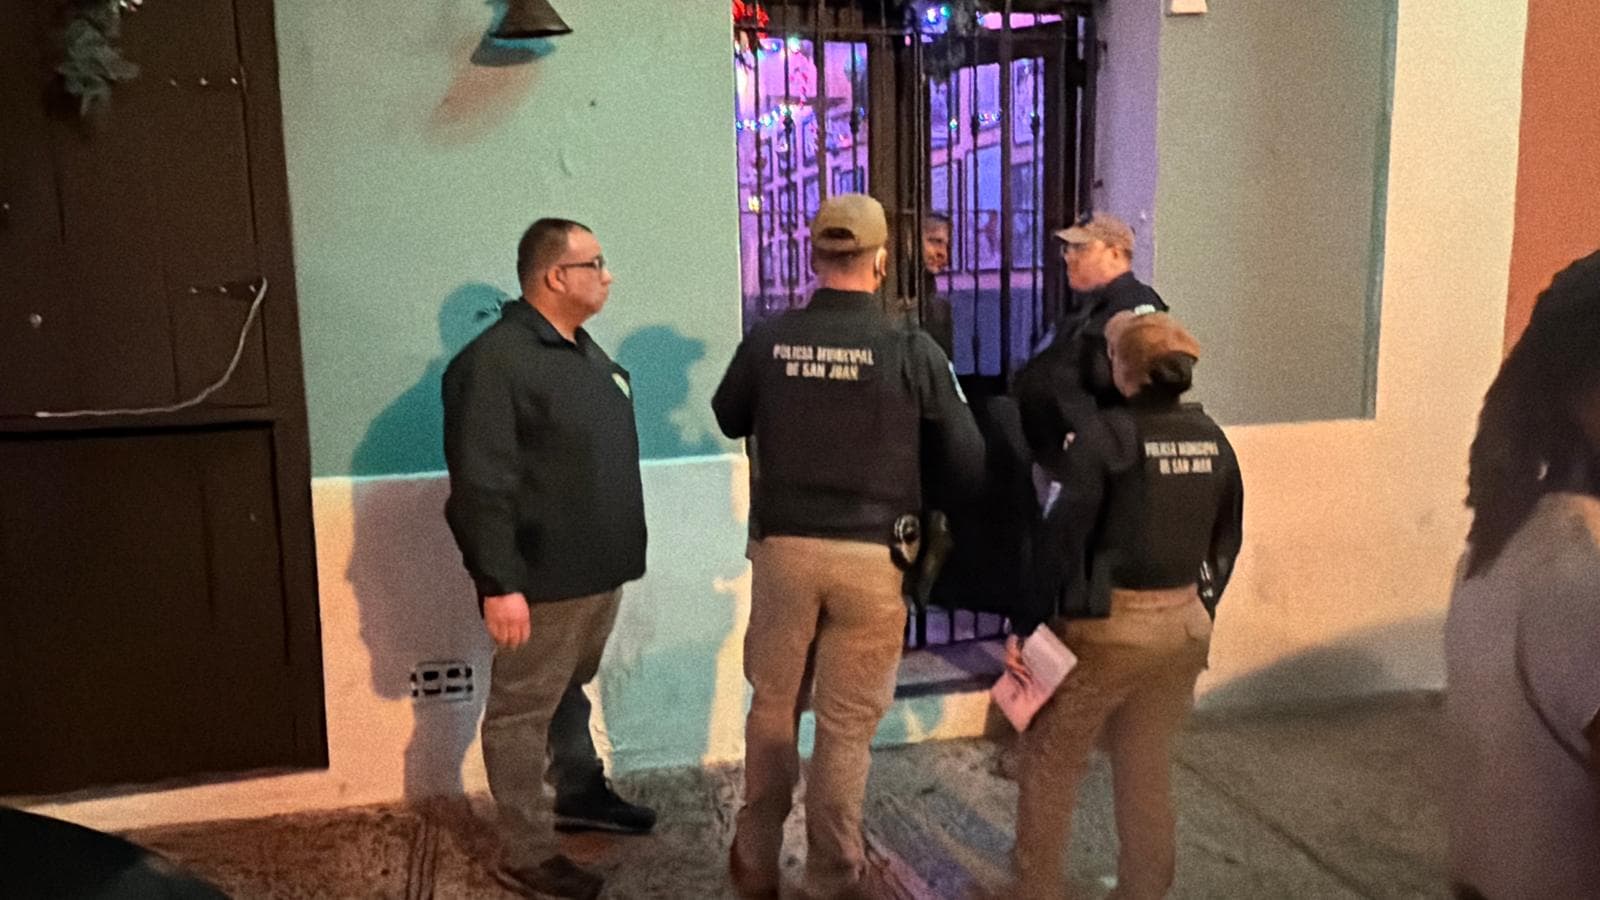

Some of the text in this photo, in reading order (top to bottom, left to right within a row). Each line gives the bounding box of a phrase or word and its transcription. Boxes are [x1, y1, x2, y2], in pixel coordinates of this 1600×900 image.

[786, 361, 859, 381] DE SAN JUAN
[1172, 458, 1190, 474] SAN
[1192, 457, 1213, 473] JUAN
